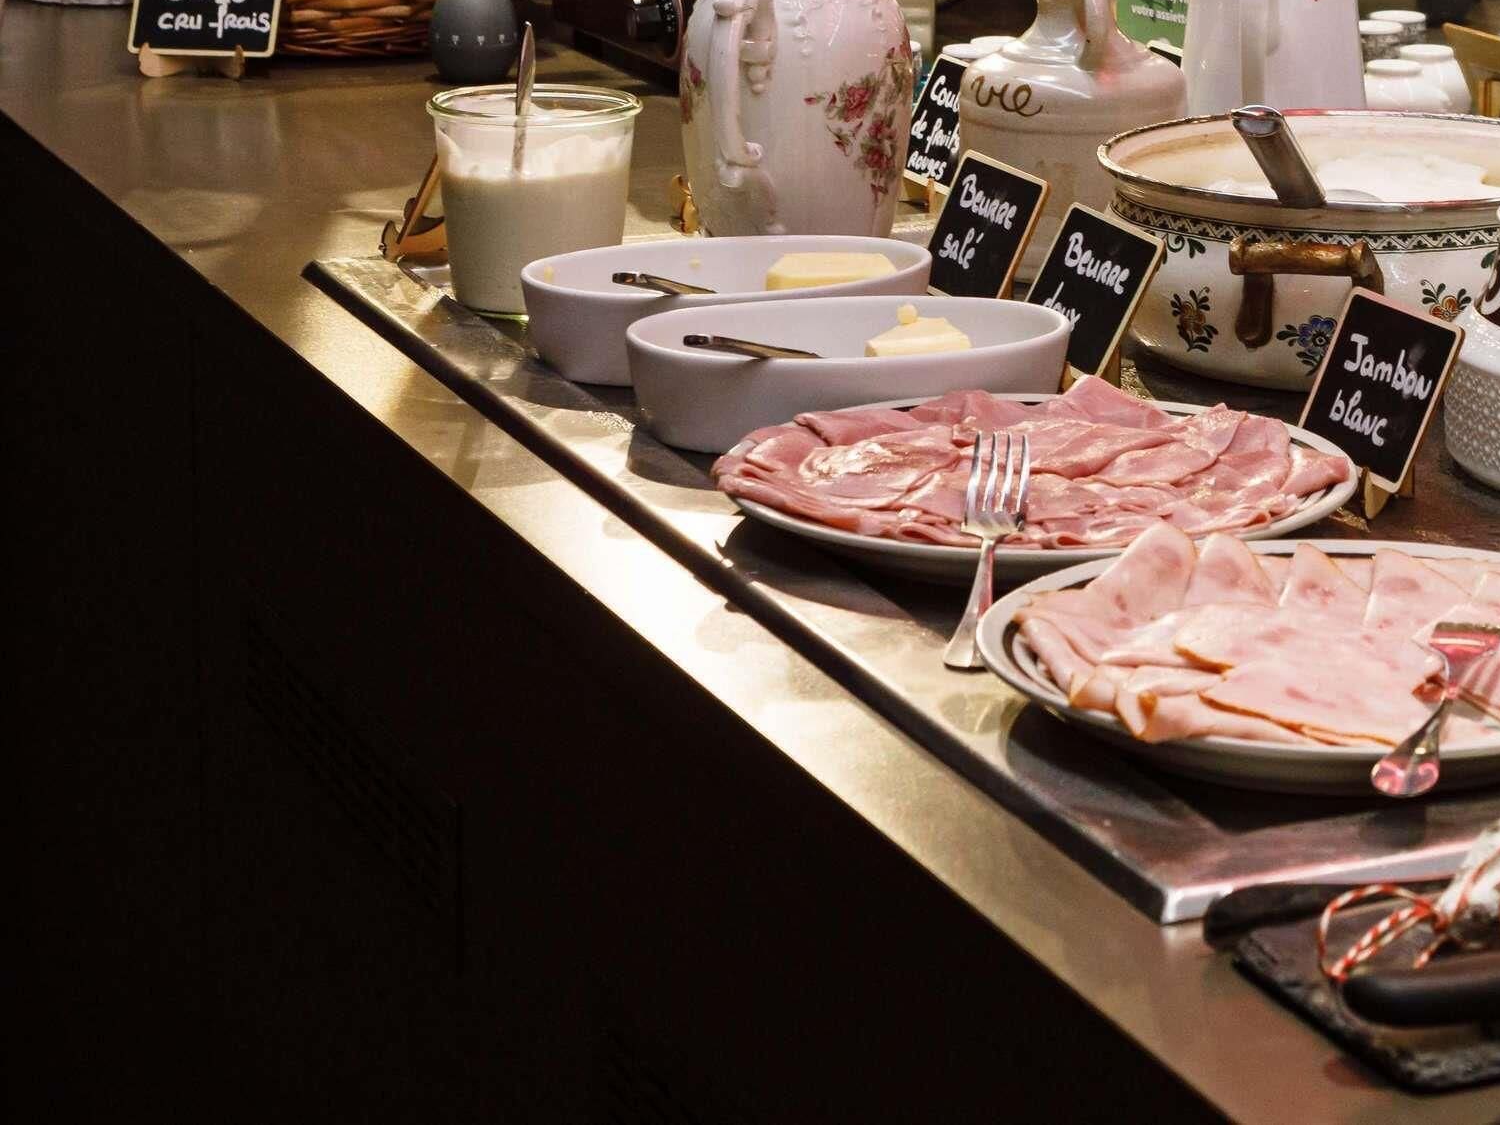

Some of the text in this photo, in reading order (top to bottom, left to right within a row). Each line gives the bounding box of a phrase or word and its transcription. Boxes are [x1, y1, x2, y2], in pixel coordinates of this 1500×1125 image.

[1131, 4, 1155, 18] votre
[970, 76, 1043, 117] vie
[911, 110, 928, 140] de
[1343, 333, 1432, 401] Jambon
[1329, 389, 1388, 447] blanc
